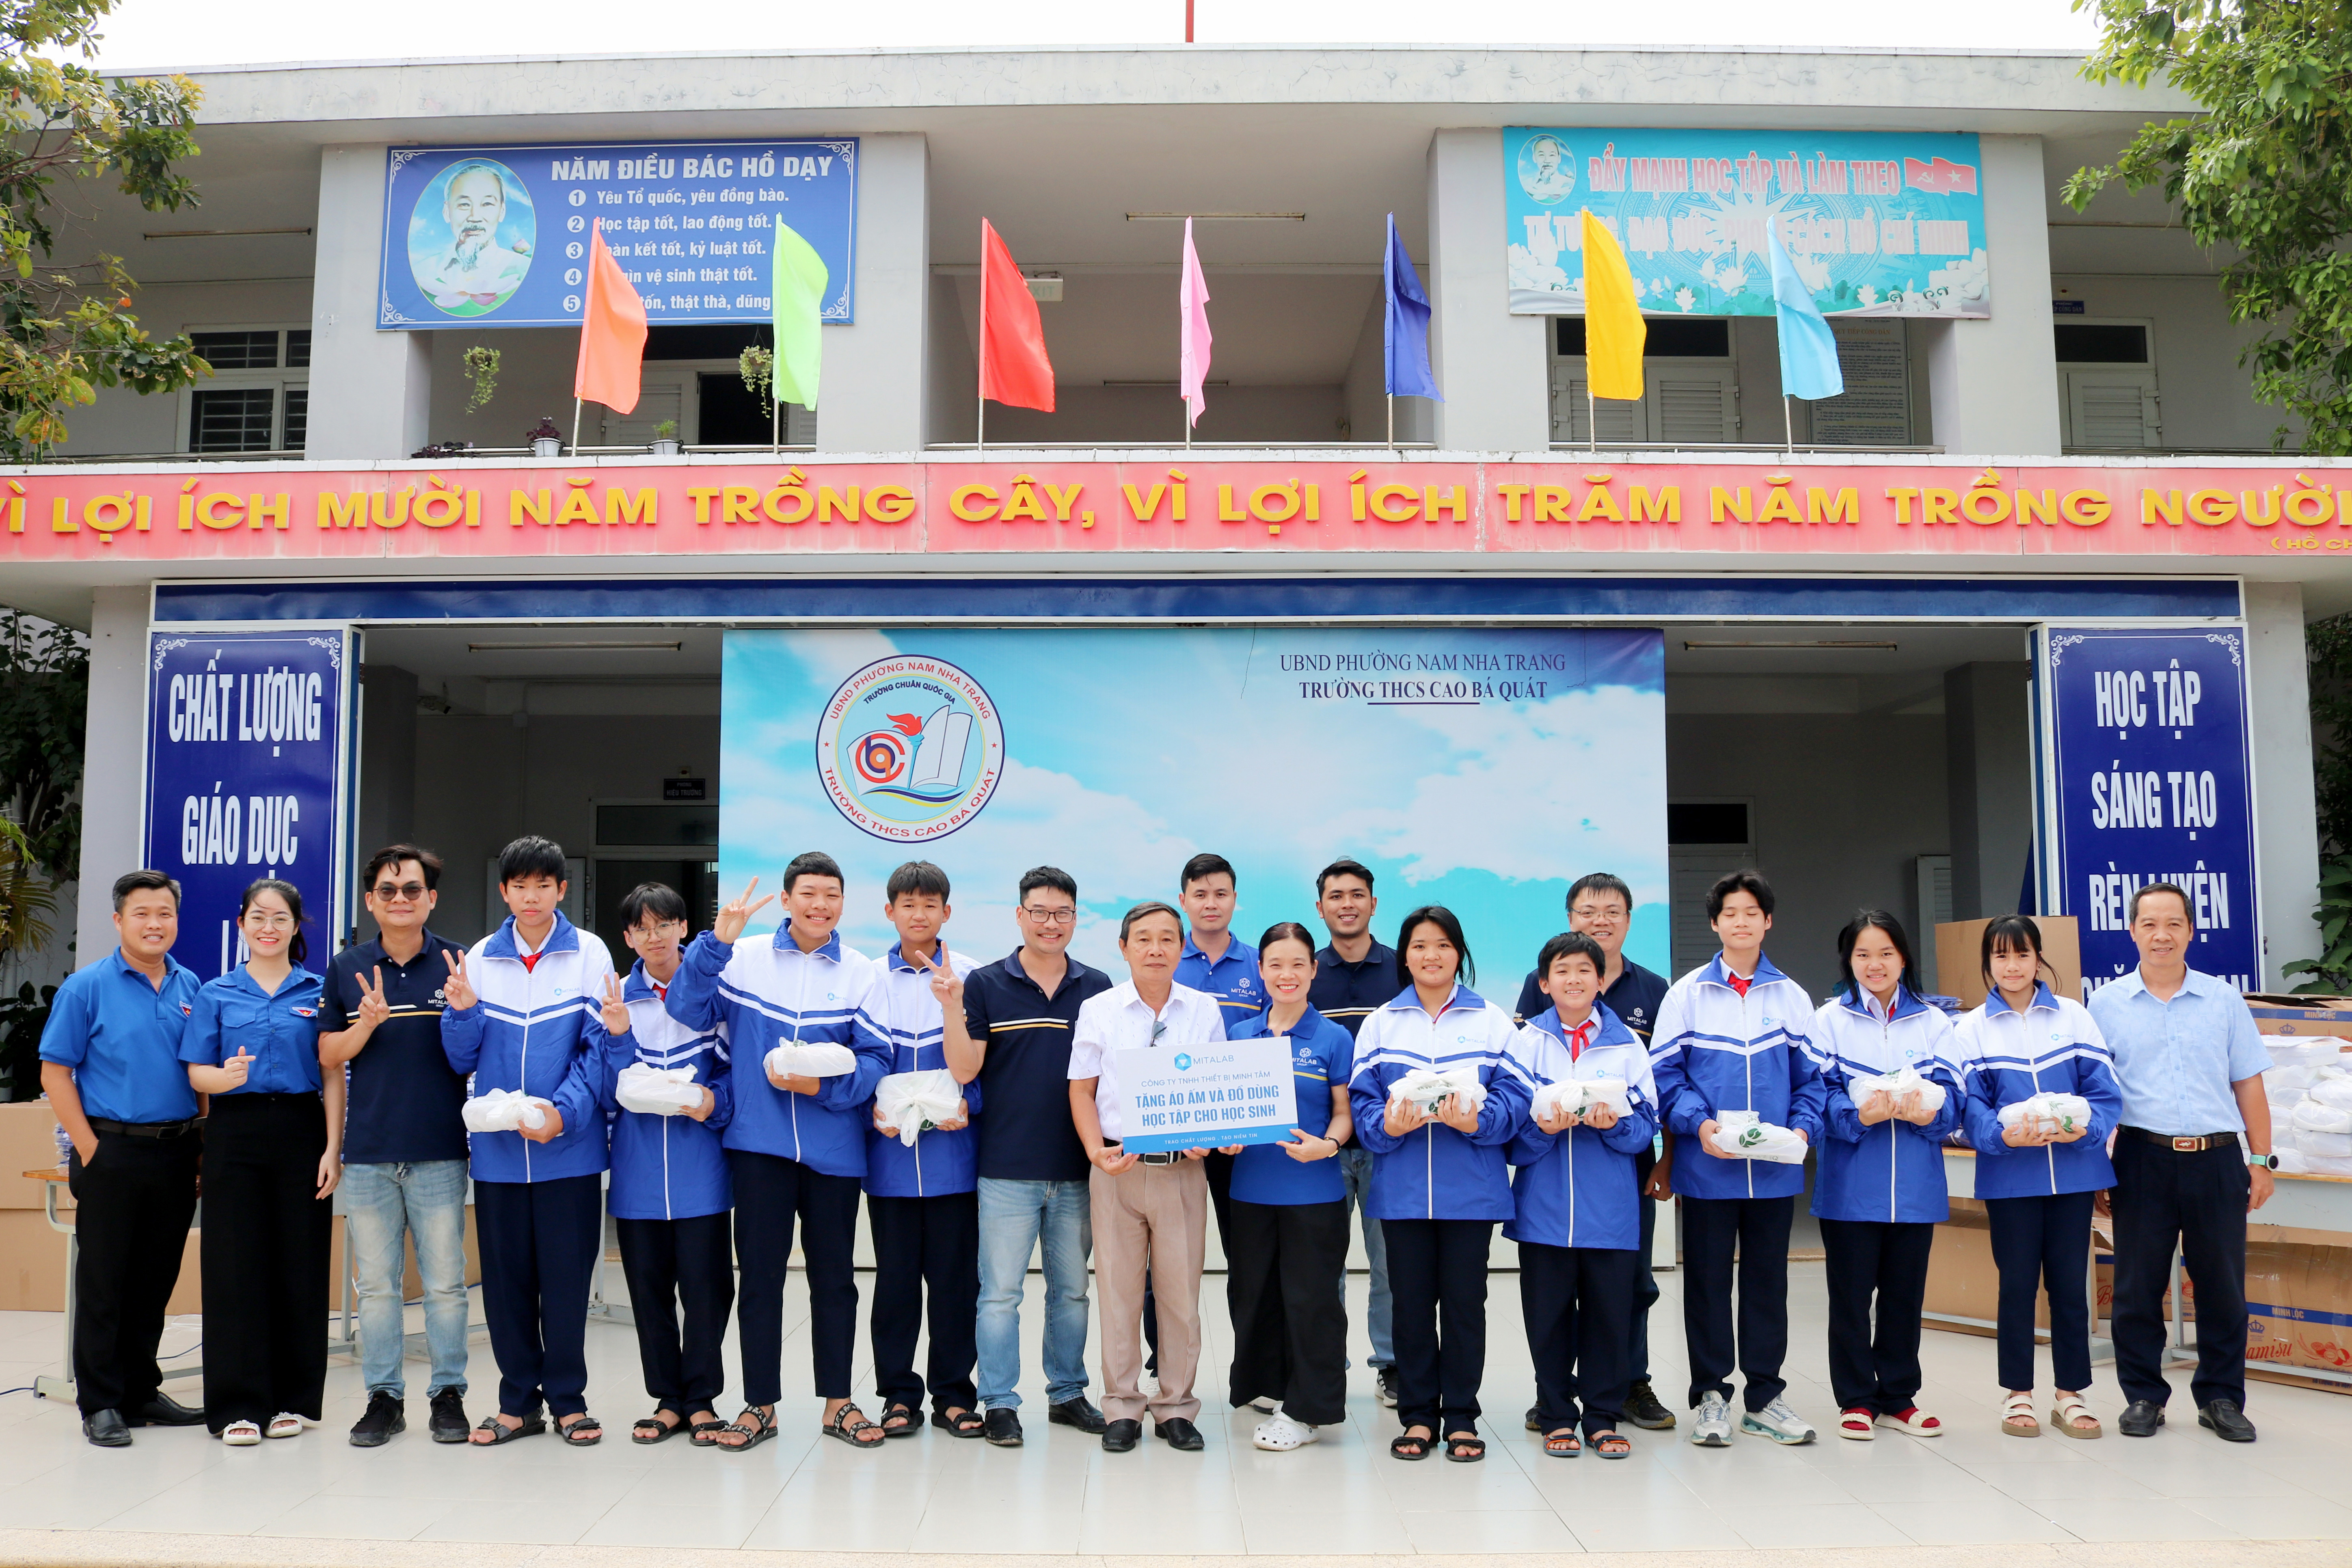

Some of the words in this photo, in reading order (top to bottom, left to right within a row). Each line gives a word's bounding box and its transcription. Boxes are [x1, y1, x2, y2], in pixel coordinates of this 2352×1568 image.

[551, 156, 609, 181] NĂM
[617, 152, 675, 179] ĐIỀU
[682, 154, 733, 179] BÁC
[741, 150, 775, 177] HỒ
[783, 156, 833, 181] DẠY
[1630, 157, 1689, 201] MẠNH
[1692, 157, 1733, 201] HỌC
[1735, 150, 1773, 201] TẬP
[1775, 151, 1804, 194] VÀ
[1806, 151, 1849, 195] LÀM
[1850, 159, 1901, 196] THEO
[596, 190, 622, 204] Yêu
[626, 187, 644, 204] Tổ
[648, 188, 686, 207] quốc,
[690, 189, 715, 206] yêu
[719, 187, 754, 205] đồng
[759, 188, 789, 202] bào.
[626, 216, 650, 233] tập
[654, 214, 678, 232] tốt,
[682, 216, 704, 229] lao
[708, 214, 743, 232] động
[747, 212, 771, 229] tốt.
[1792, 212, 1845, 254] CÁCH
[1880, 212, 1915, 255] CHÍ
[1918, 220, 1969, 255] MINH
[607, 242, 630, 256] oàn
[634, 241, 657, 256] kết
[661, 240, 685, 258] tốt,
[689, 240, 706, 258] kỷ
[710, 241, 738, 257] luật
[742, 239, 766, 255] tốt.
[646, 268, 662, 285] vệ
[666, 268, 695, 283] sinh
[700, 268, 729, 284] thật
[733, 265, 758, 281] tốt.
[1027, 285, 1055, 298] XIT
[670, 295, 699, 312] thật
[704, 294, 731, 310] thà,
[736, 294, 771, 311] dũng
[52, 490, 151, 543] LỢI
[178, 476, 290, 530] ÍCH
[317, 473, 480, 529] MƯỜI
[510, 477, 657, 526] NĂM
[687, 465, 916, 524] TRỒNG
[949, 474, 1095, 529] CÂY,
[1123, 469, 1188, 521] VÌ
[1218, 478, 1320, 535] LỢI
[1349, 469, 1467, 522] ÍCH
[1497, 474, 1680, 523] TRĂM
[1710, 476, 1860, 524] NĂM
[1885, 467, 2112, 526] TRỒNG
[2141, 473, 2352, 526] NGƯỜI
[2286, 531, 2320, 550] HỒ
[1281, 654, 1331, 671] UBND
[1335, 650, 1412, 671] PHƯỜNG
[1417, 654, 1458, 671] NAM
[1463, 654, 1501, 671] NHA
[1504, 654, 1566, 671] TRANG
[830, 688, 854, 719] UBND
[853, 662, 905, 690] PHƯỜNG
[908, 662, 935, 673] NAM
[937, 667, 961, 686] NHA
[964, 682, 991, 719] TRANG
[863, 685, 894, 704] TRƯỜNG
[944, 692, 956, 704] GIA
[1299, 677, 1374, 698] TRƯỜNG
[1379, 682, 1425, 698] THCS
[1430, 682, 1467, 698] CAO
[1472, 677, 1495, 698] BÁ
[1498, 676, 1547, 701] QUÁT
[2094, 670, 2147, 740] HỌC
[2153, 658, 2201, 740] TẬP
[168, 649, 233, 743] CHẤT
[239, 666, 322, 757] LƯỢNG
[825, 766, 868, 824] TRƯỜNG
[870, 820, 910, 837] THCS
[914, 822, 948, 837] CAO
[949, 807, 971, 825] BÁ
[970, 767, 995, 808] QUÁT
[2091, 759, 2162, 829] SÁNG
[2167, 771, 2217, 841] TẠO
[182, 781, 241, 865] GIÁO
[247, 795, 299, 879] DỤC
[1231, 988, 1257, 996] MITALAB
[1627, 1016, 1647, 1024] MITALAB
[1193, 1054, 1234, 1064] MITALAB
[1141, 1079, 1165, 1087] CÔNG
[1201, 1073, 1222, 1083] THIẾT
[1224, 1074, 1231, 1083] BỊ
[1233, 1072, 1253, 1081] MINH
[1255, 1071, 1271, 1079] TÂM
[1135, 1090, 1166, 1109] TẶNG
[1169, 1089, 1184, 1106] ÁO
[1188, 1087, 1206, 1104] ẤM
[1209, 1086, 1225, 1103] VÀ
[1228, 1084, 1244, 1101] ĐỒ
[1247, 1084, 1279, 1100] DÙNG
[1142, 1112, 1166, 1128] HỌC
[1169, 1109, 1190, 1126] TẬP
[1194, 1109, 1218, 1123] CHO
[1221, 1108, 1245, 1123] HỌC
[1248, 1104, 1276, 1118] SINH
[2272, 1307, 2291, 1317] MINH
